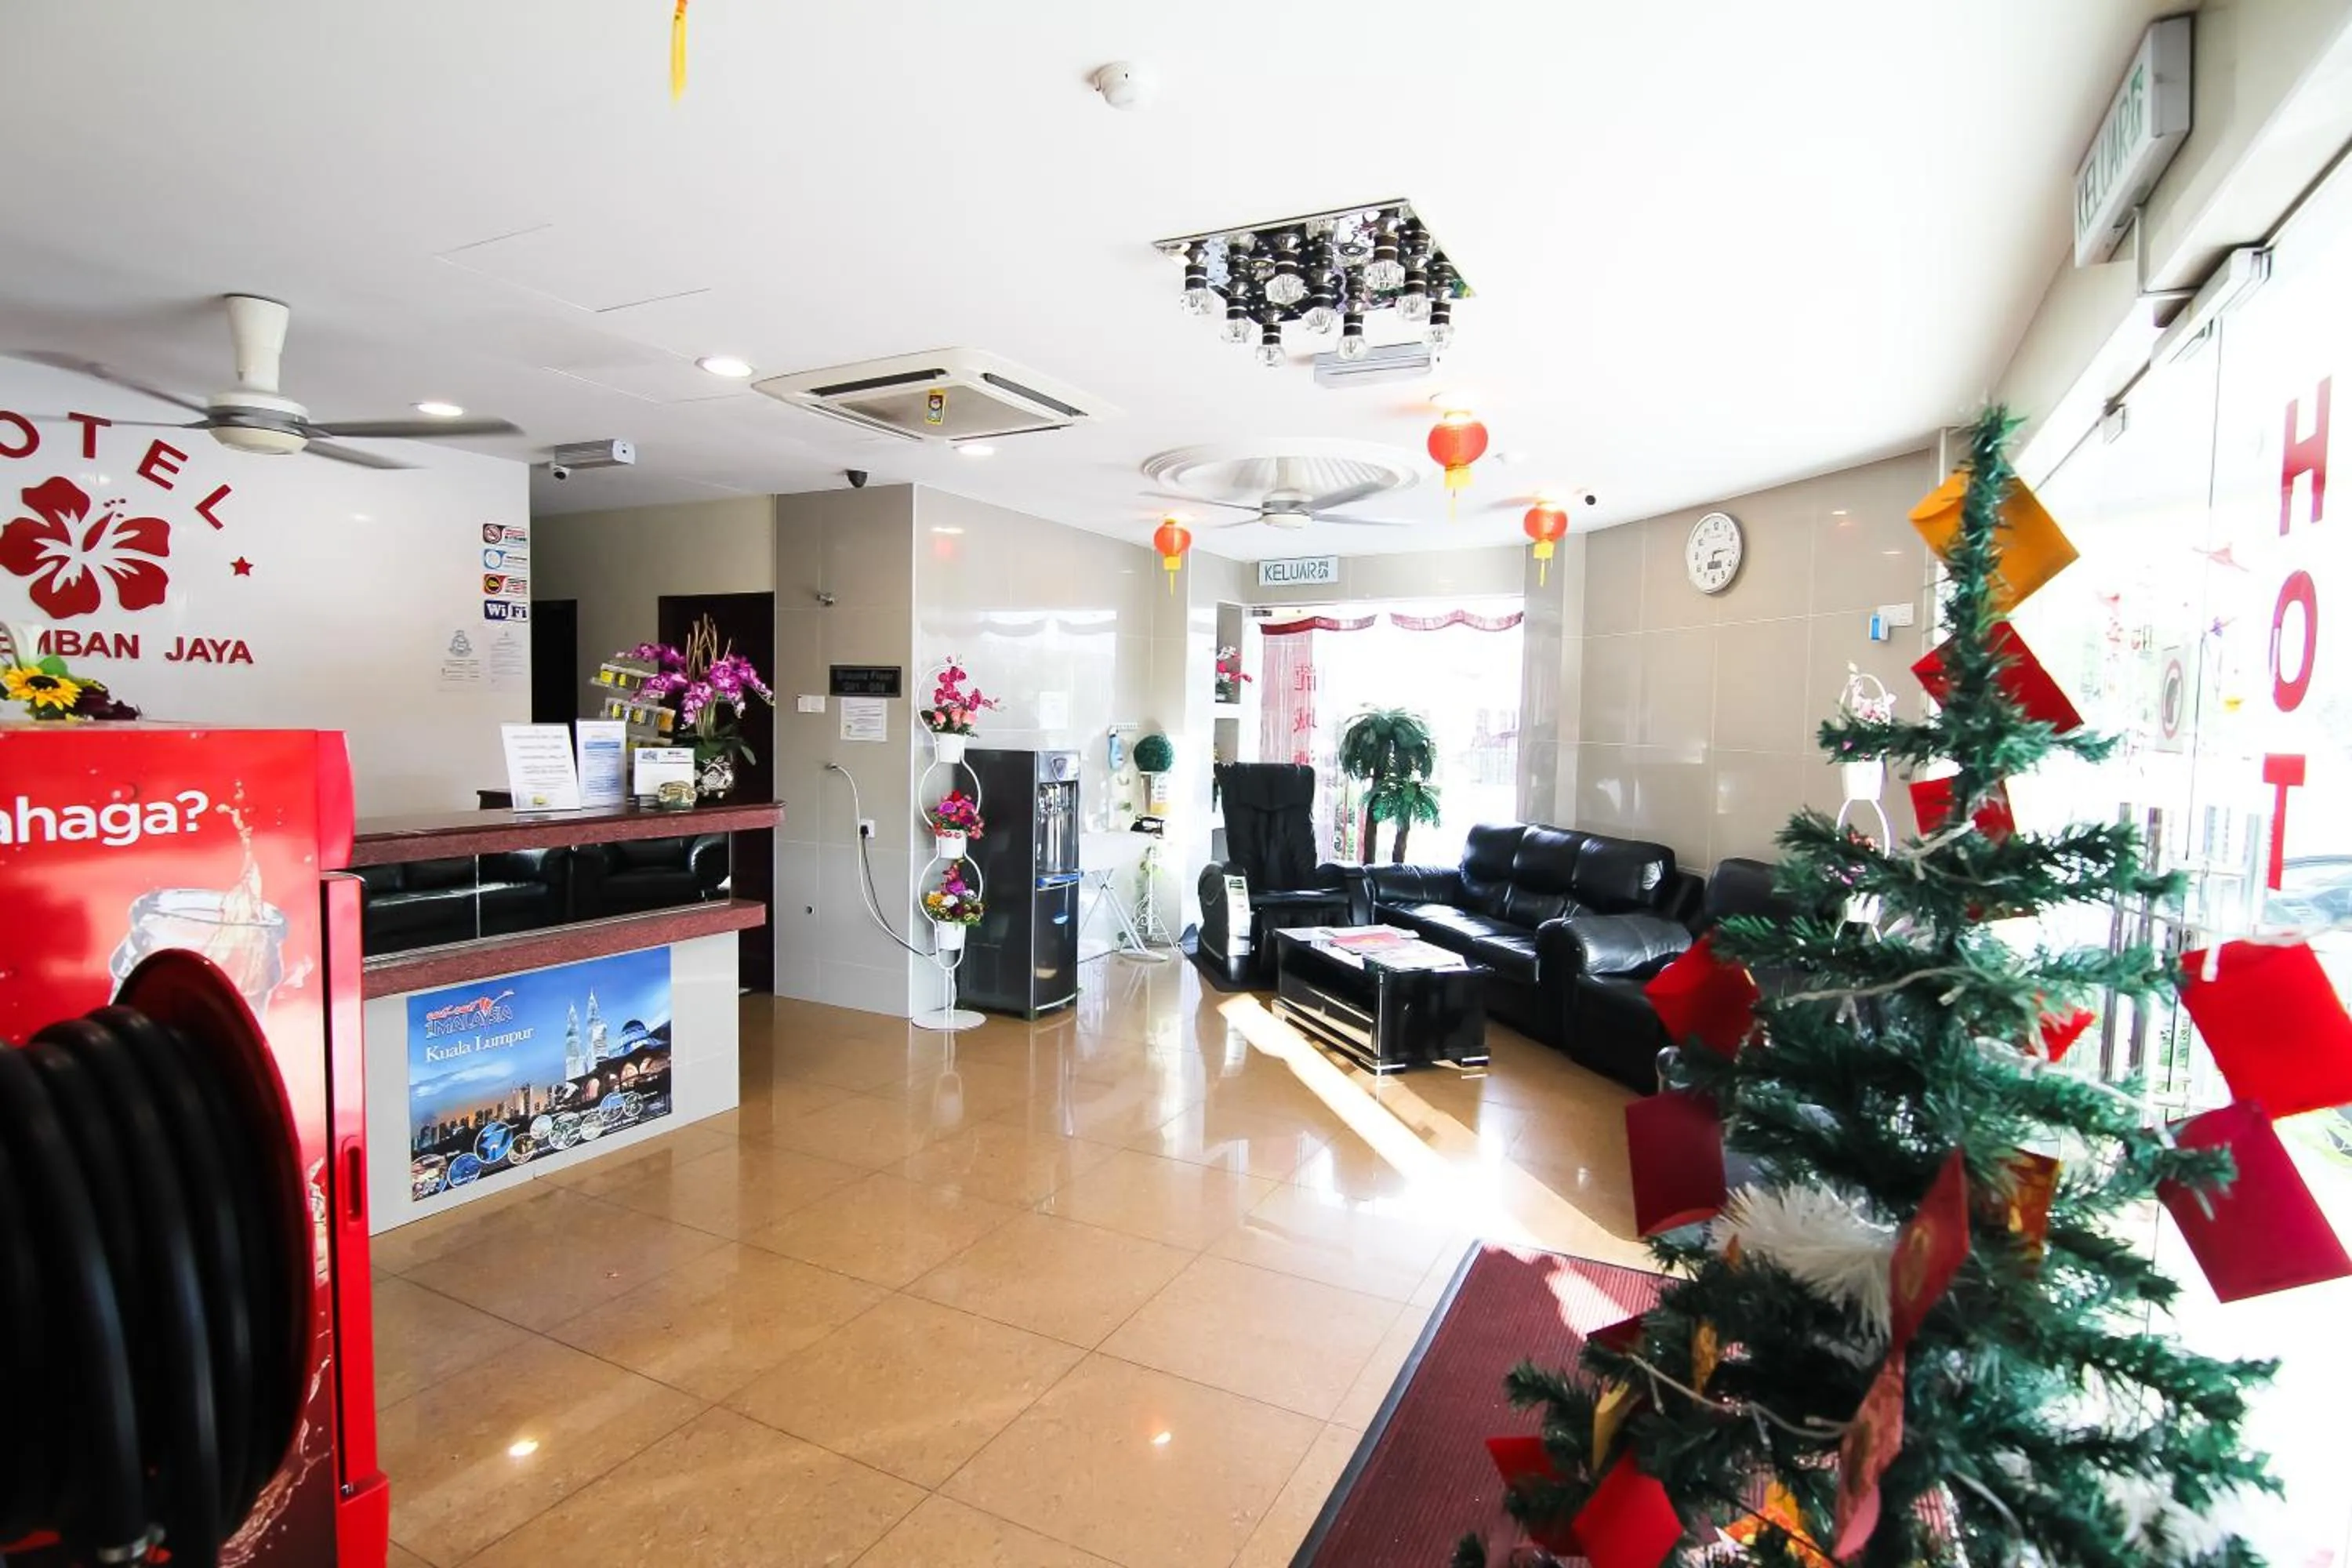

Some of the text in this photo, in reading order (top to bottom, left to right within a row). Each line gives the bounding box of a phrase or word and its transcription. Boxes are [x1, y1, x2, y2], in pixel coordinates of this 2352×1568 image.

[2078, 93, 2129, 240] KELUAR
[1265, 562, 1316, 581] KELUAR
[165, 637, 253, 664] JAYA
[426, 1028, 535, 1062] Kuala Lumpur
